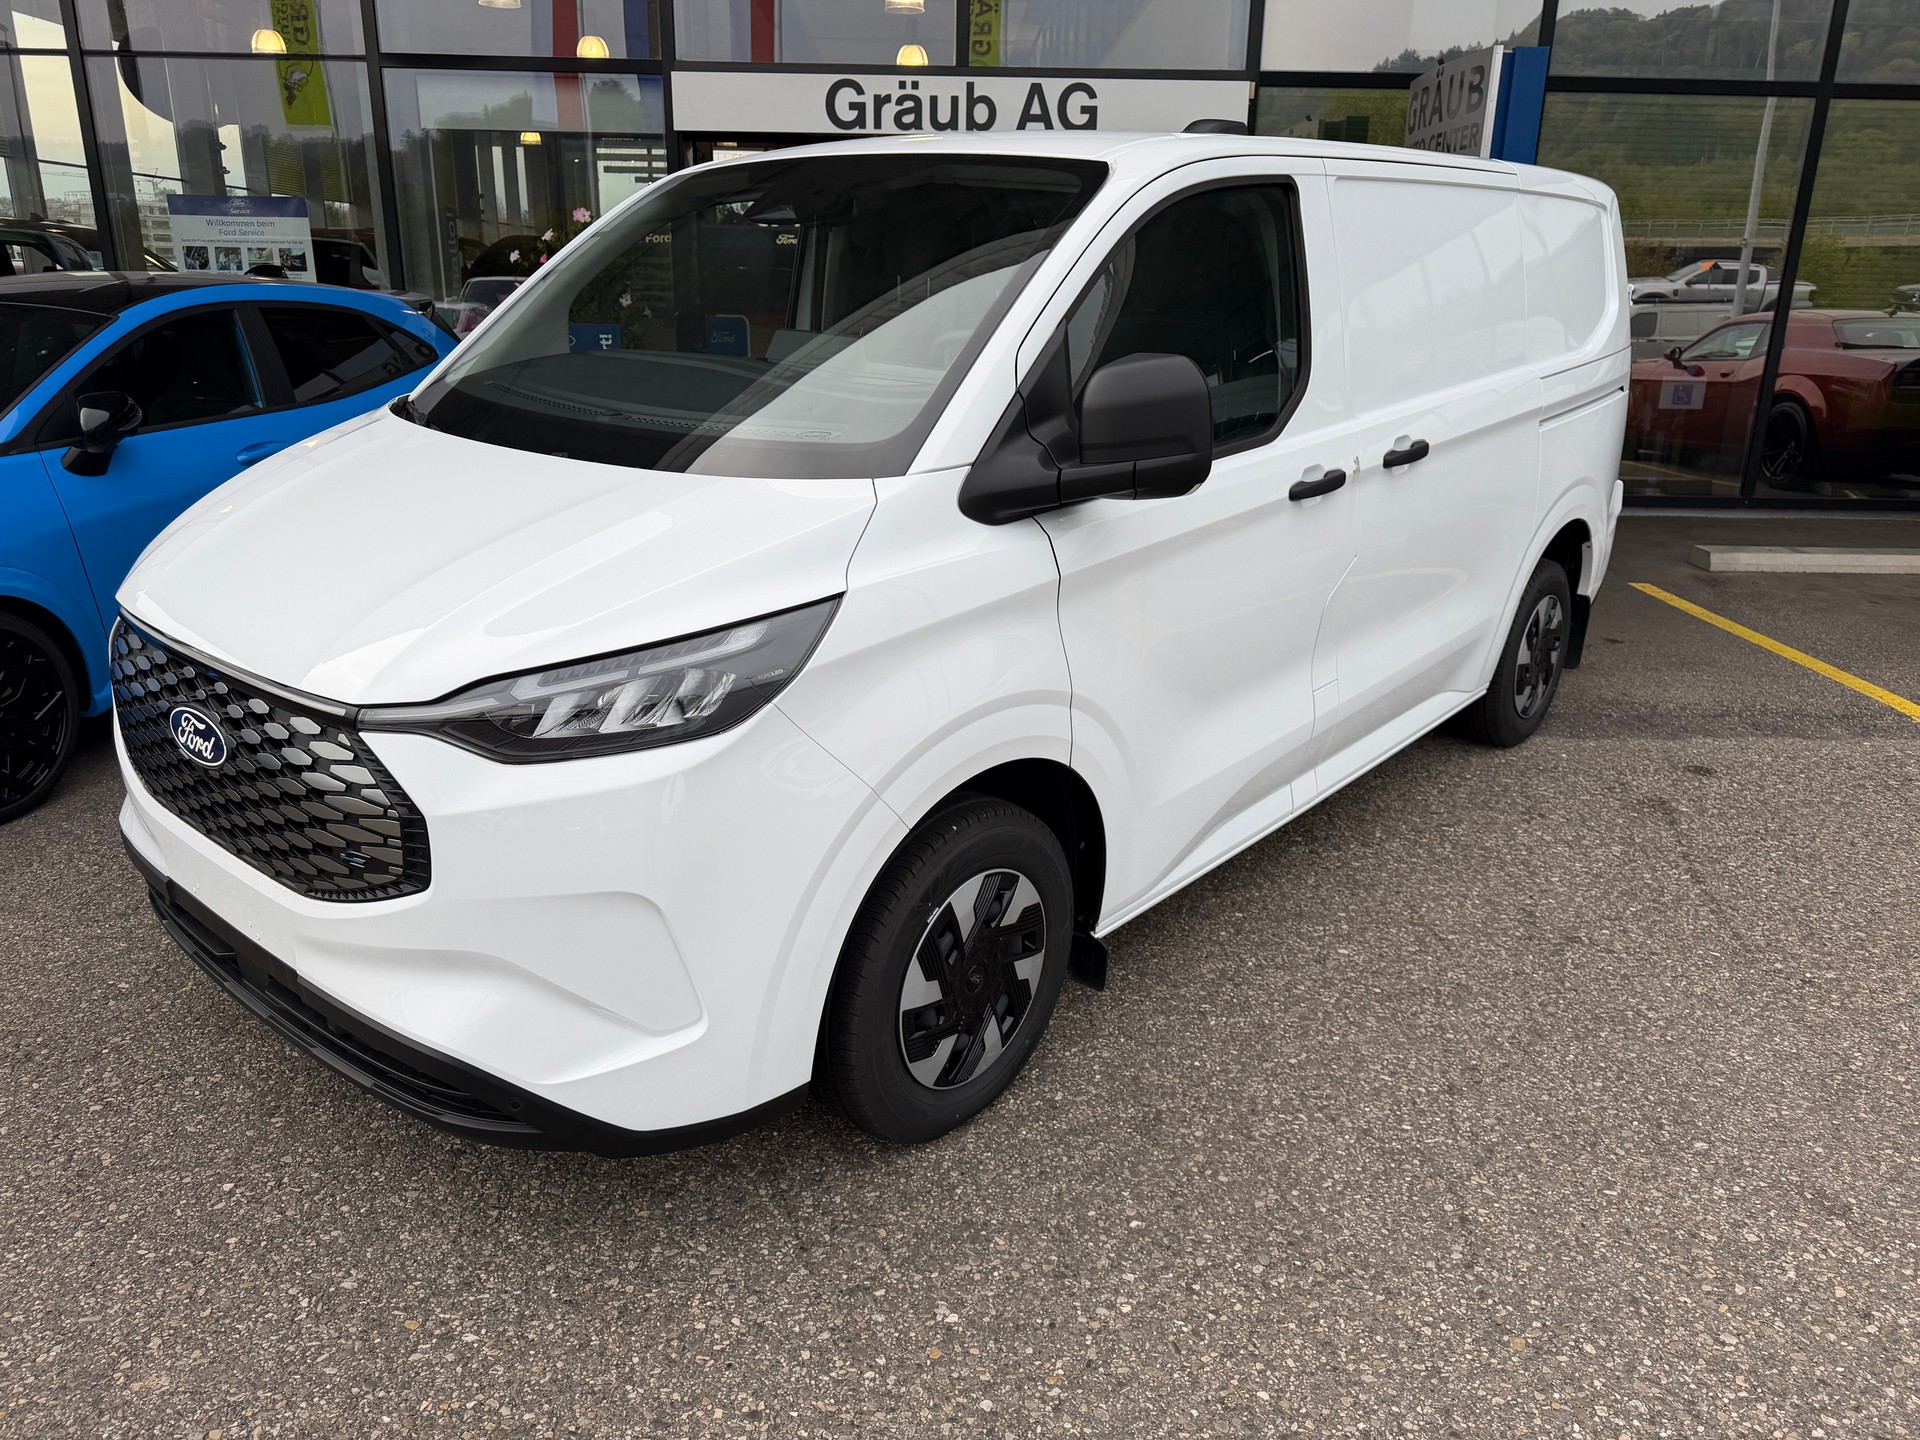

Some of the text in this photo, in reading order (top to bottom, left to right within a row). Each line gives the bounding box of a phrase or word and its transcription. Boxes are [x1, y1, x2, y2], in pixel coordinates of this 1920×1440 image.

[825, 78, 1098, 131] Gräub AG
[1407, 65, 1486, 136] GRÄUB
[205, 219, 275, 228] Willkommen beim
[238, 229, 265, 237] Service
[710, 330, 736, 343] Ford
[177, 712, 216, 760] Ford
